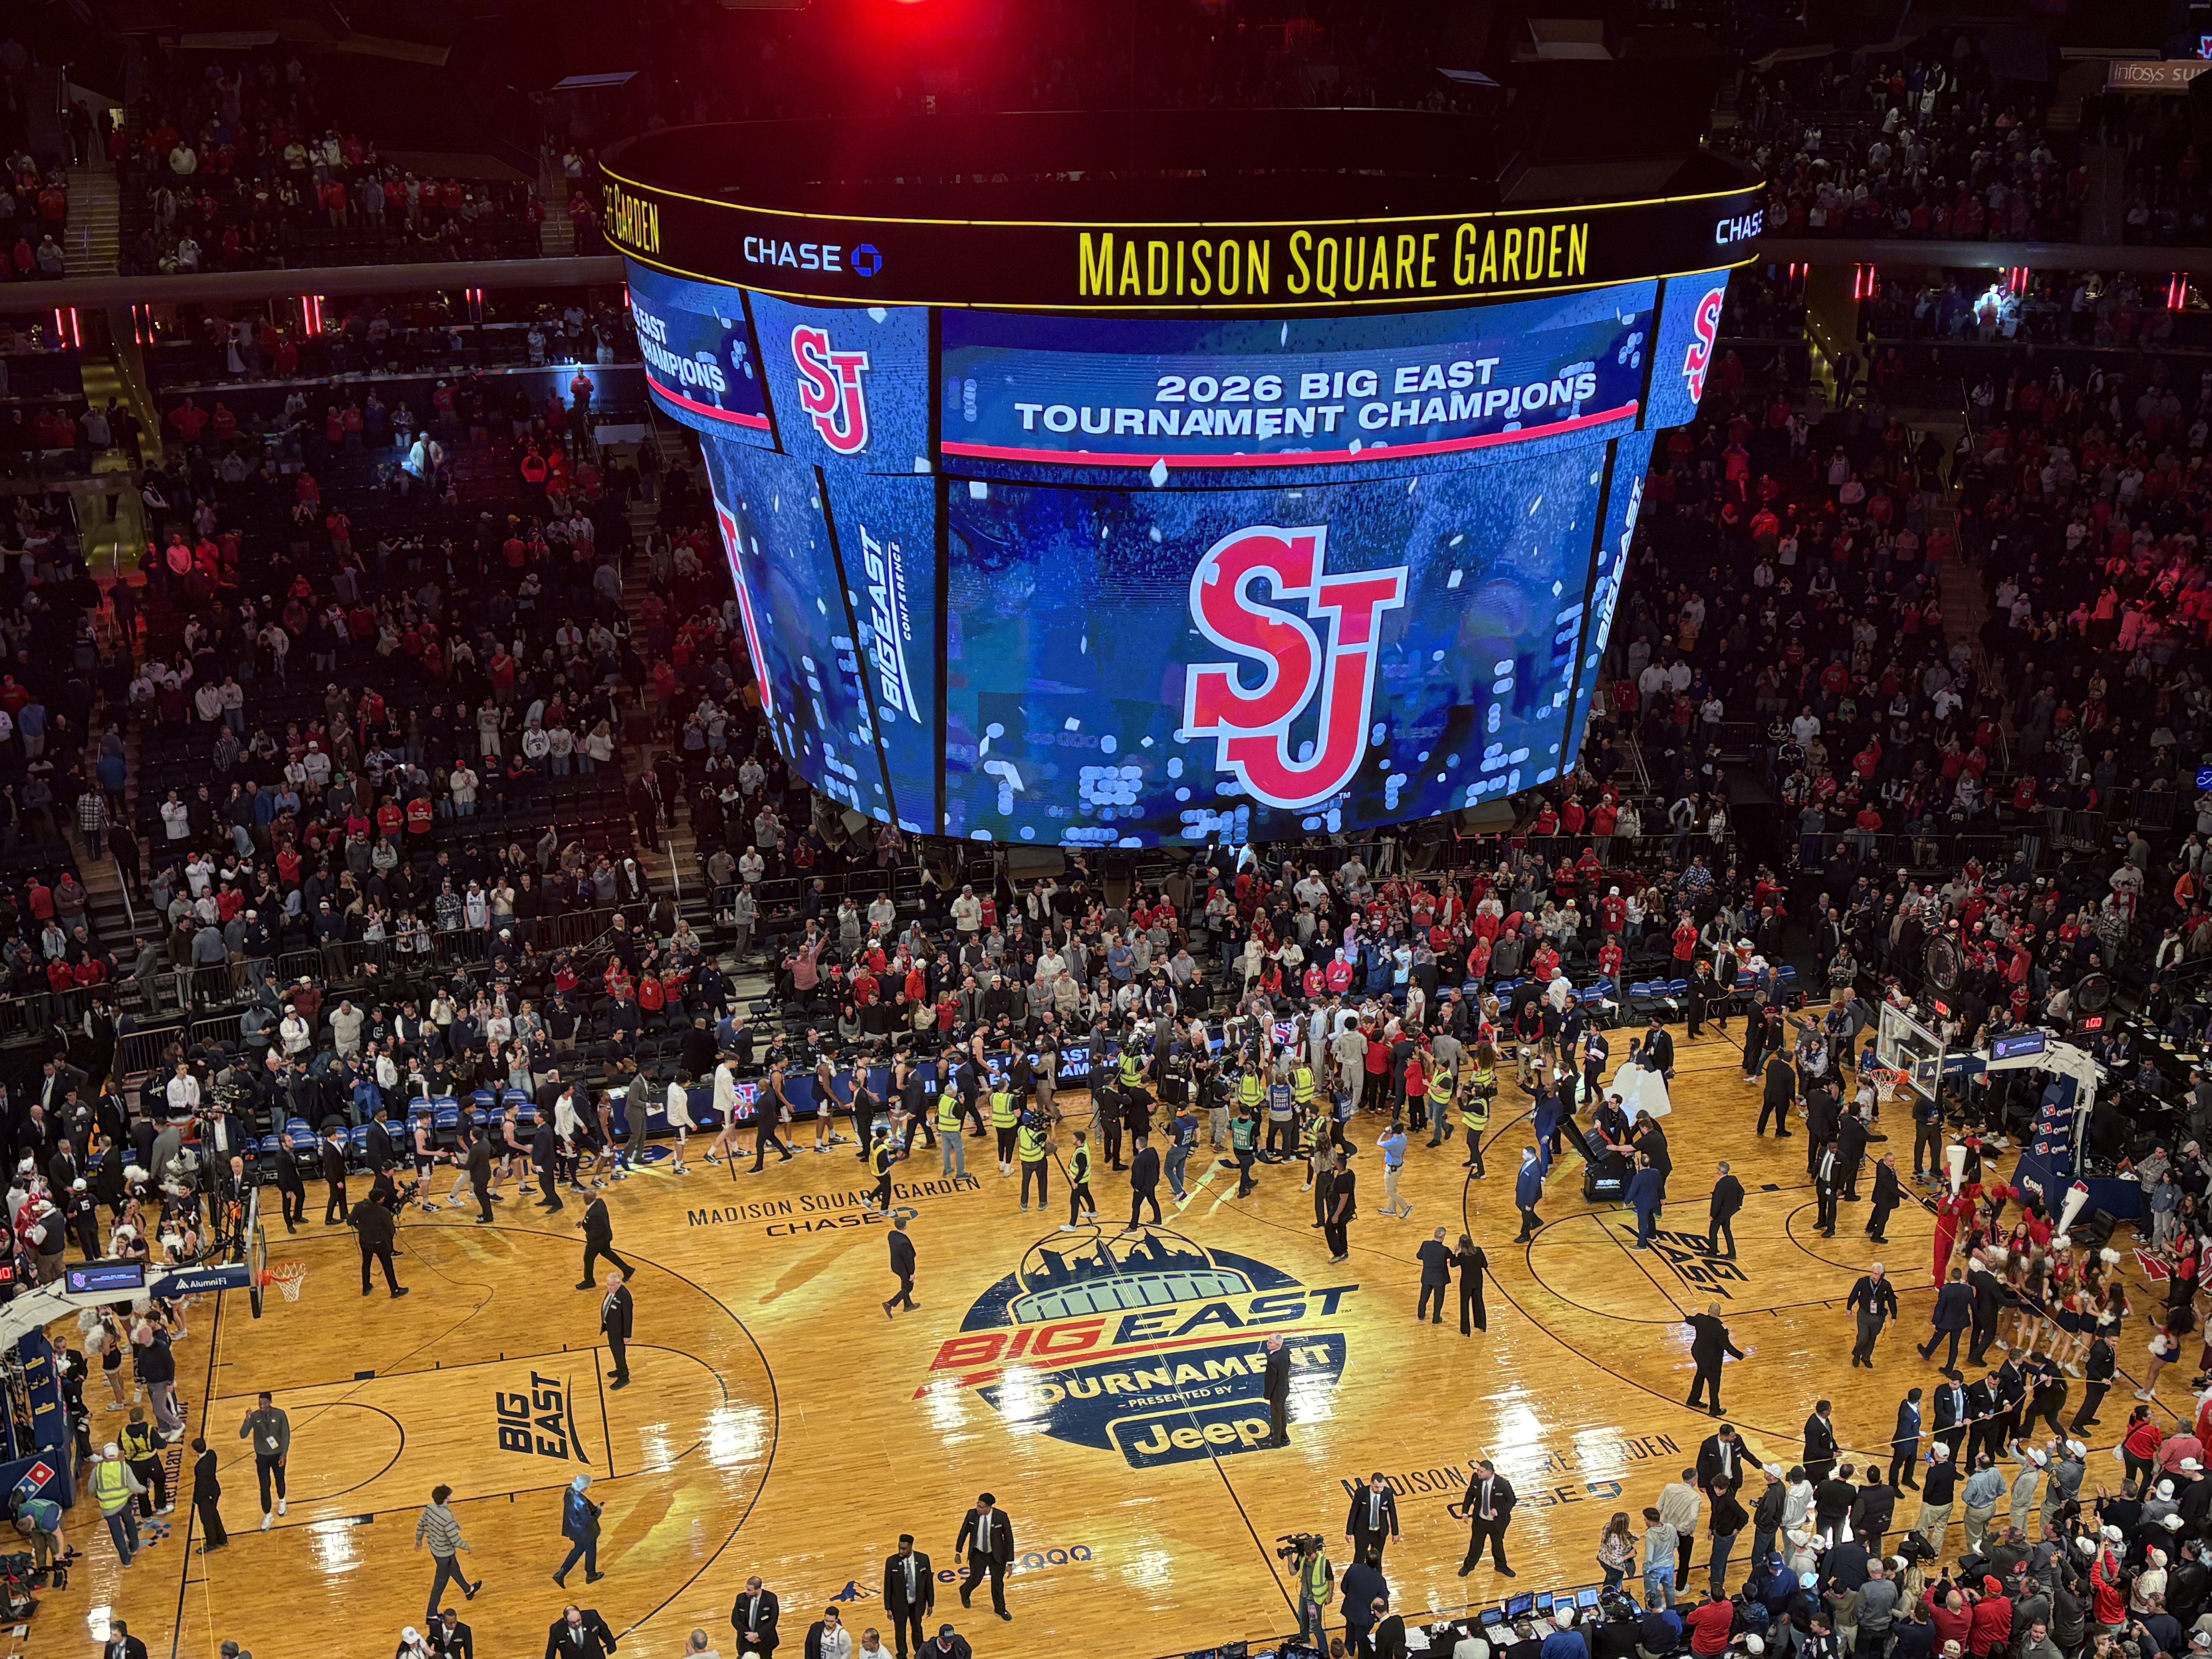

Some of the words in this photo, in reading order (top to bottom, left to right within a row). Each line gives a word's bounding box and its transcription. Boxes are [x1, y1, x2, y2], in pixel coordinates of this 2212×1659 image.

[2114, 64, 2165, 84] Infosys
[614, 183, 659, 254] GARDEN
[744, 236, 842, 271] CHASE
[1080, 232, 1270, 296] MADISON
[1287, 230, 1437, 298] SQUARE
[1453, 223, 1589, 286] GARDEN
[641, 340, 726, 392] CHAMPIONS
[1156, 374, 1283, 403] 2026
[1299, 369, 1378, 401] BIG
[1393, 356, 1500, 396] EAST
[1015, 403, 1344, 437] TOURNAMENT
[1358, 371, 1597, 431] CHAMPIONS
[892, 541, 912, 641] CONFERENCE
[80, 1200, 90, 1211] 15
[687, 1199, 794, 1227] MADISON
[895, 1176, 981, 1200] GARDEN
[766, 1211, 884, 1237] CHASE
[929, 1317, 1106, 1371] BIG
[1113, 1283, 1360, 1345] EAST
[1042, 1344, 1331, 1405] OURNAMENT
[1128, 1388, 1211, 1408] PRESENTED
[1214, 1385, 1232, 1395] BY
[496, 1391, 534, 1455] BIG
[530, 1370, 570, 1460] EAST
[1133, 1417, 1271, 1455] Jeep
[1023, 1544, 1092, 1569] QQQ
